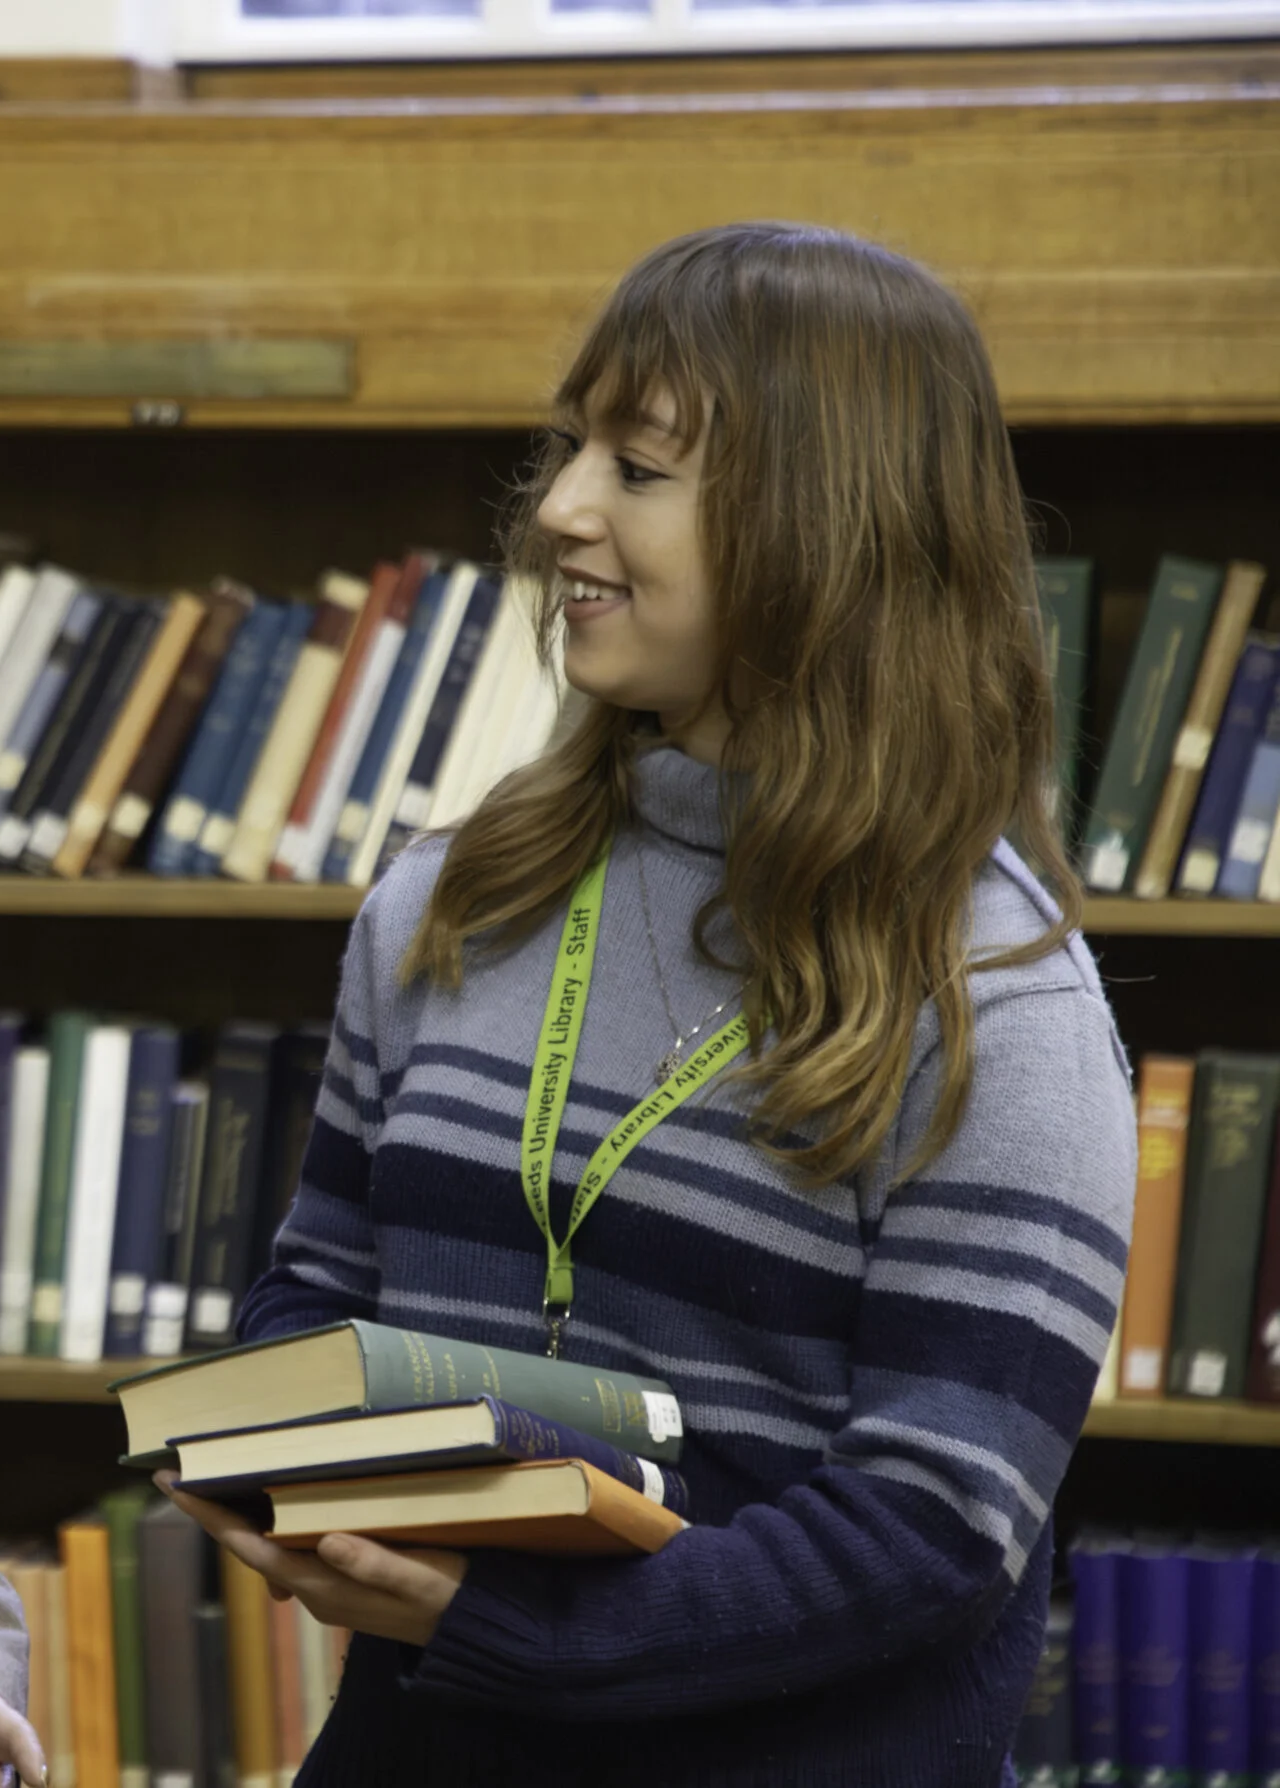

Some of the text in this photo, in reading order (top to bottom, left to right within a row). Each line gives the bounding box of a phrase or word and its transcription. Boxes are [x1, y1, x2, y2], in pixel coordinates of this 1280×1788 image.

[566, 908, 591, 956] Staff
[548, 977, 582, 1045] Library
[674, 1017, 749, 1088] niversity
[529, 1053, 567, 1154] University
[610, 1090, 674, 1151] Library
[528, 1160, 547, 1227] eeds
